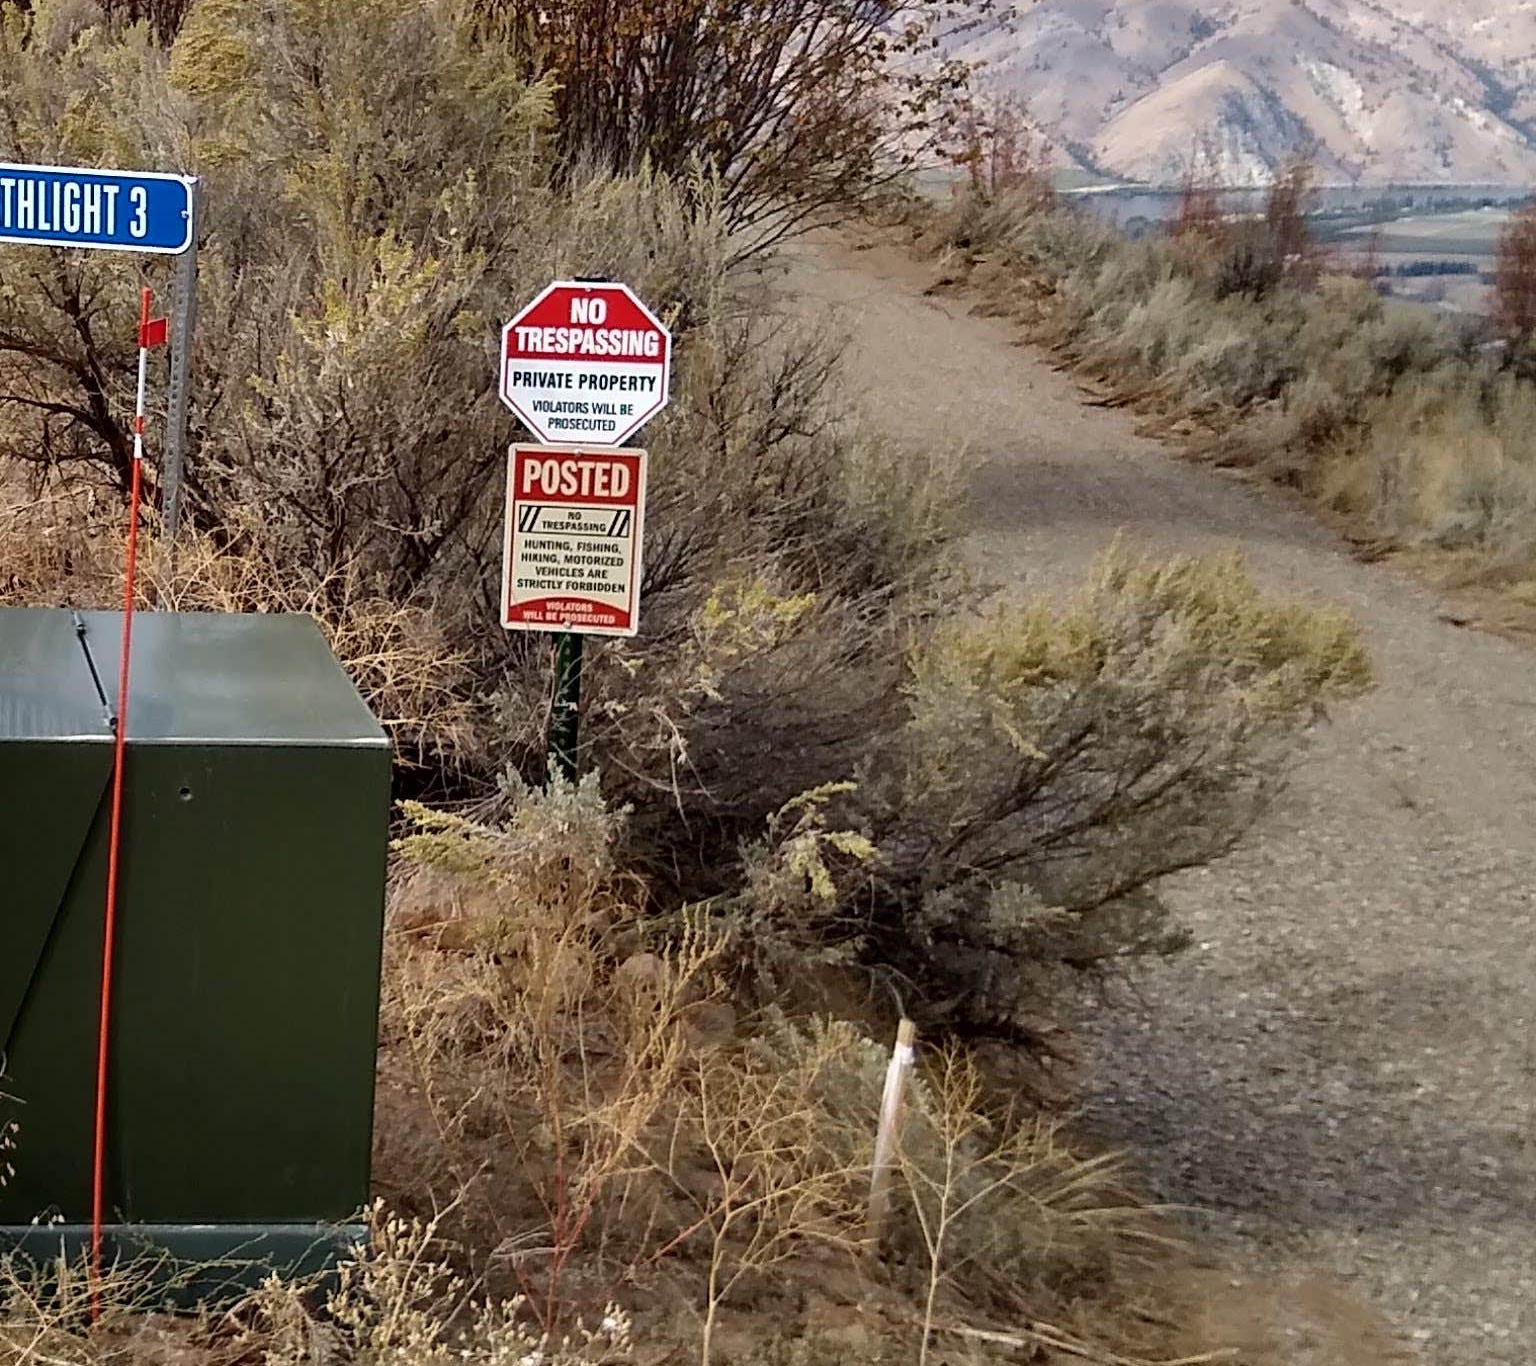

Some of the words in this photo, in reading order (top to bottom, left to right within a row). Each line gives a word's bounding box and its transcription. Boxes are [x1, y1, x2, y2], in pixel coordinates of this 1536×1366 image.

[130, 186, 147, 238] 3
[570, 297, 607, 325] NO
[515, 326, 659, 357] TRESPASSING
[513, 371, 573, 389] PRIVATE
[579, 374, 657, 392] PROPERTY
[532, 400, 589, 415] VIOLATORS
[592, 403, 617, 416] WILL
[620, 404, 634, 416] BE
[548, 417, 616, 431] PROSECUTED
[523, 459, 630, 497] POSTED
[567, 512, 582, 521] NO
[542, 521, 607, 532] TRESPASSING
[524, 539, 573, 553] HUNTING,
[577, 541, 621, 554] FISHING,
[521, 553, 560, 565] HIKING,
[564, 555, 624, 567] MOTORIZED
[535, 566, 585, 578] VEHICLES
[587, 568, 608, 579] ARE
[517, 578, 563, 590] STRICTLY
[565, 581, 625, 593] FORBIDDEN
[546, 601, 593, 612] VIOLATORS
[523, 610, 544, 620] WILL
[545, 612, 557, 621] BE
